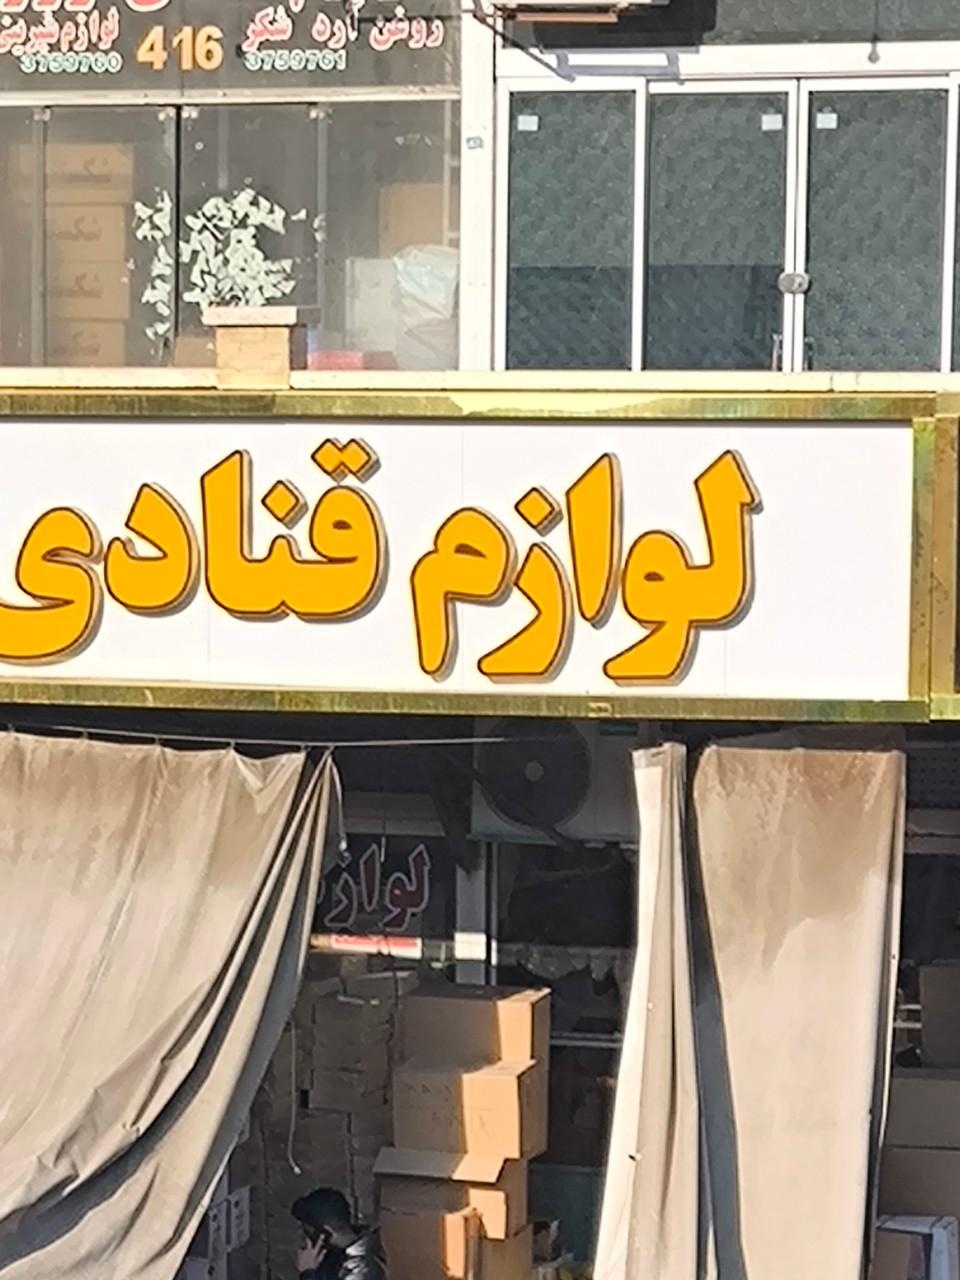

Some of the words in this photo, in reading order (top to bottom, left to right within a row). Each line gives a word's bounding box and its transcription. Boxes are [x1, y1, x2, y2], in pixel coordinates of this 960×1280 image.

[61, 6, 120, 52] لوازم
[136, 24, 224, 71] 416
[241, 5, 294, 52] شکر
[369, 5, 445, 51] روغن
[410, 448, 762, 682] لوازم
[317, 843, 431, 931] لواز
